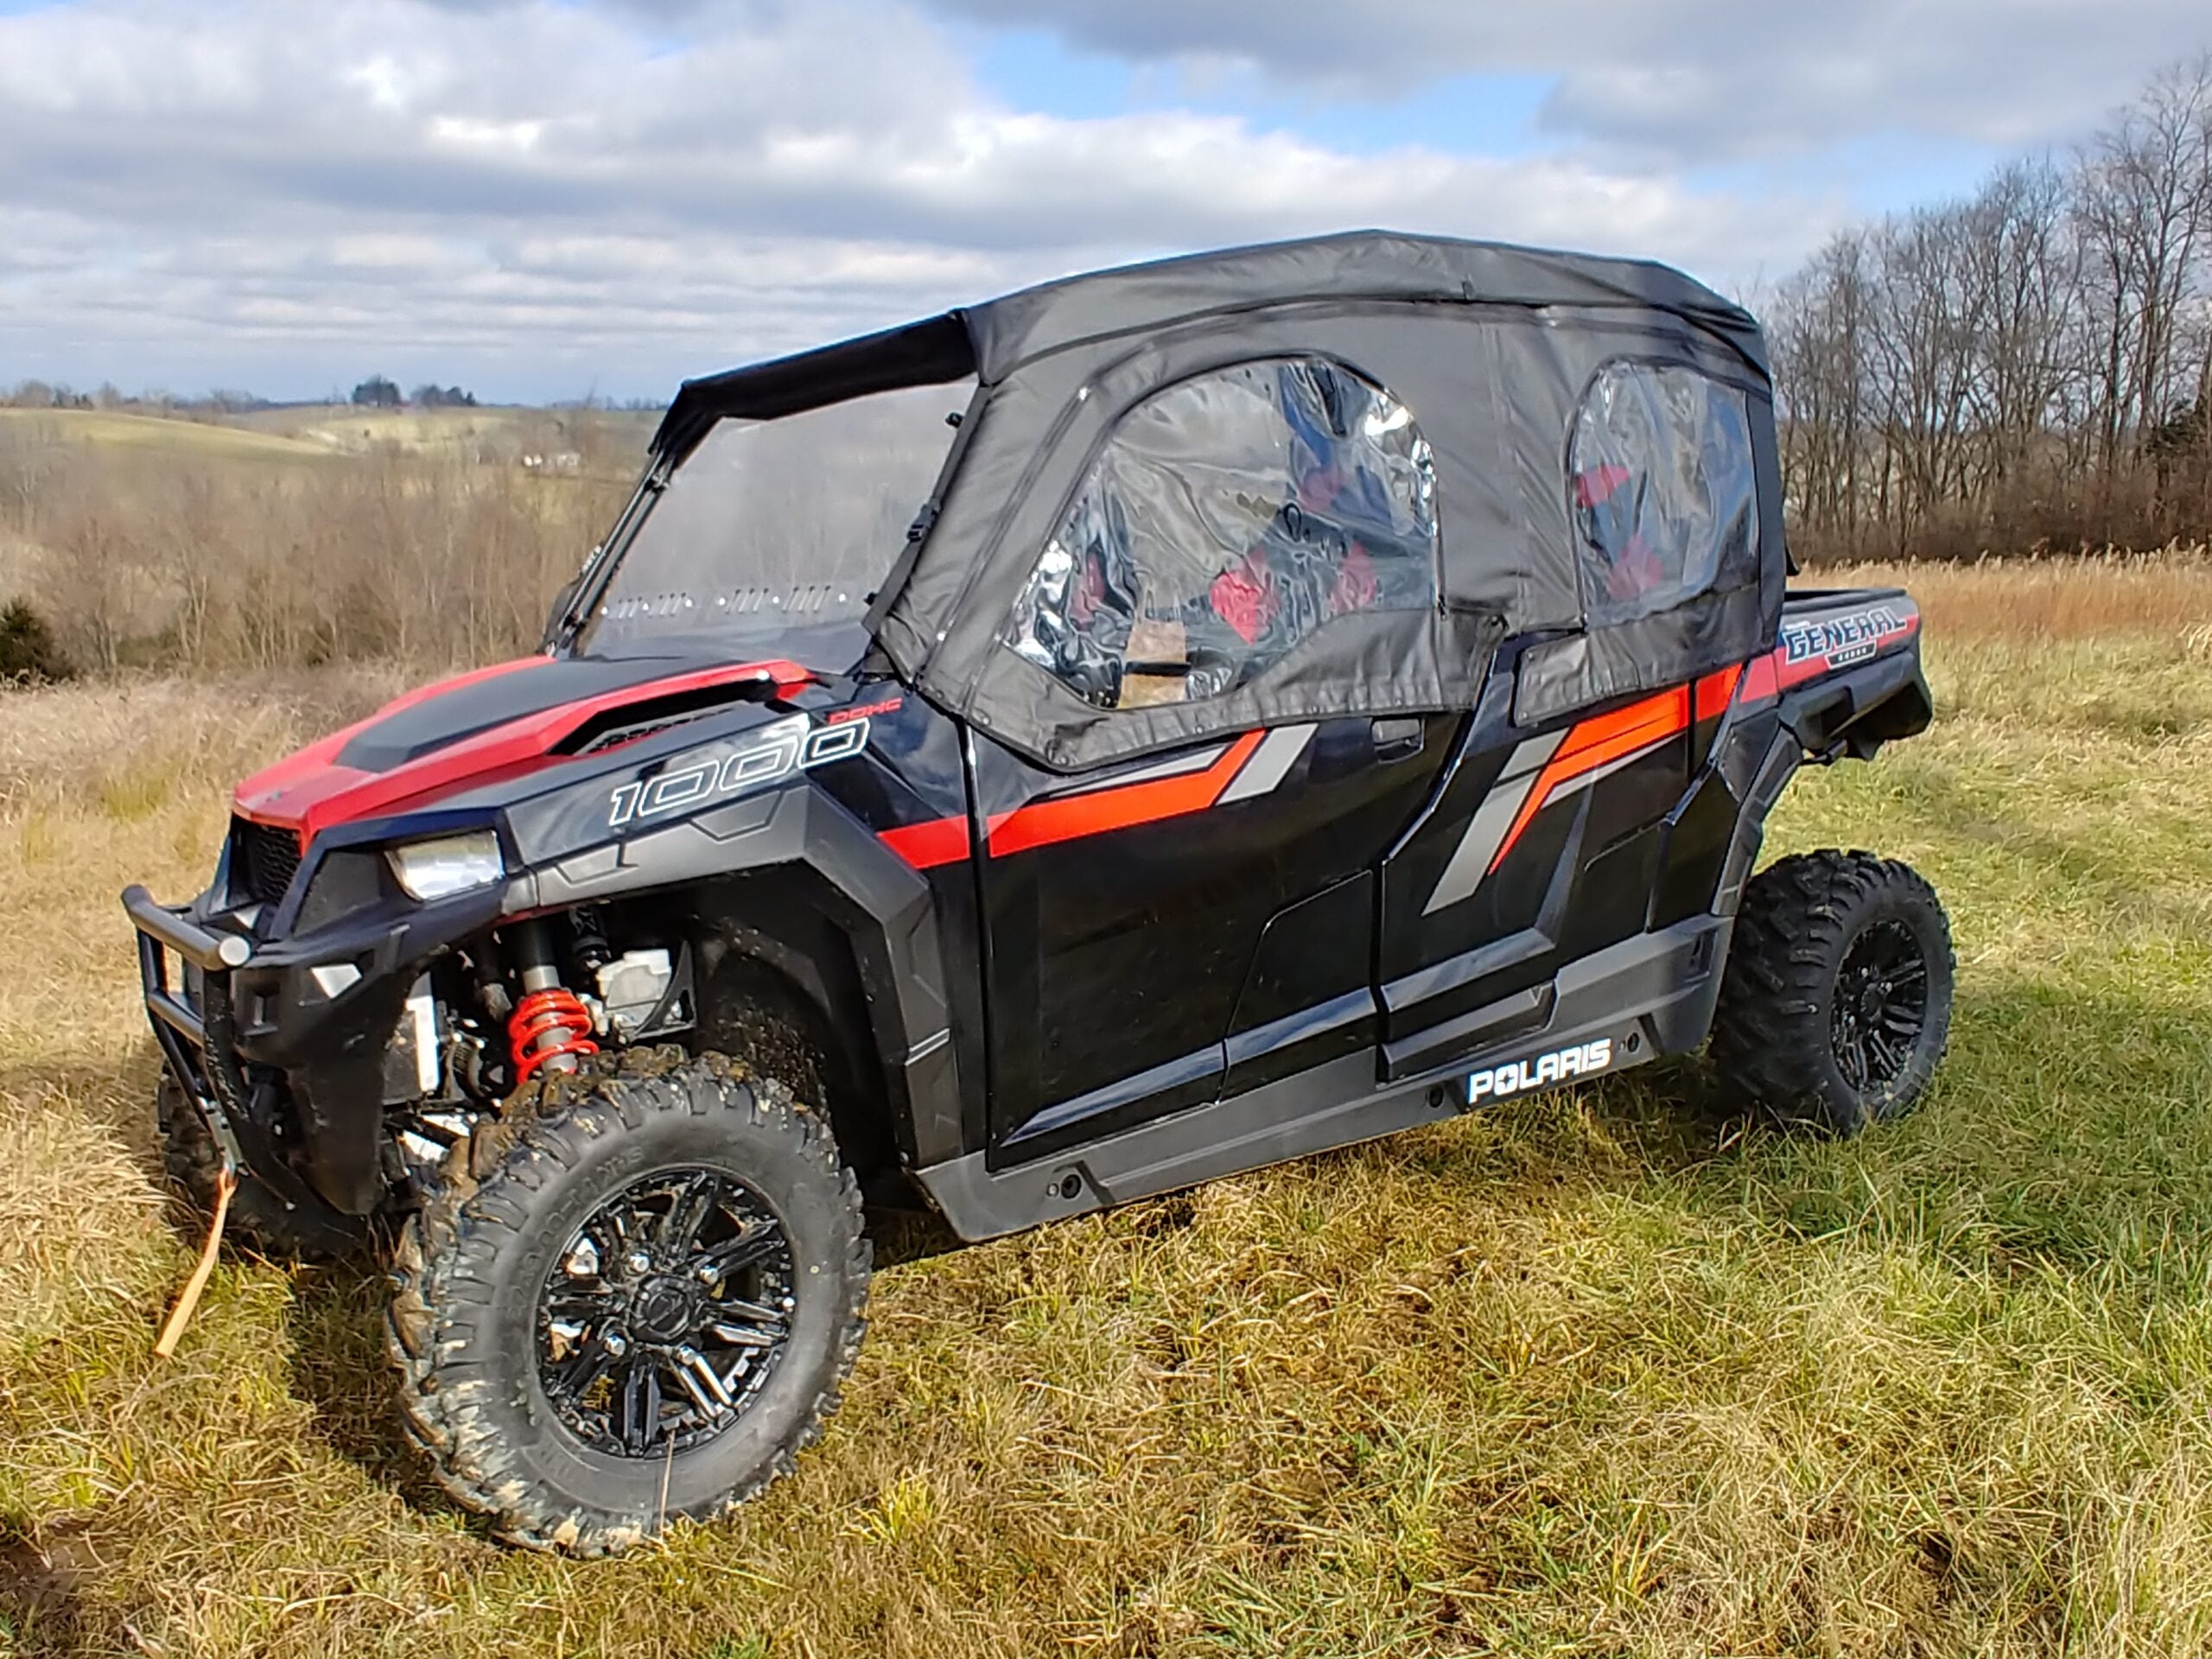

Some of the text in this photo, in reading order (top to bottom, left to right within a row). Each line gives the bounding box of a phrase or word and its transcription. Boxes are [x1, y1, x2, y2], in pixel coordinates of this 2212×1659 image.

[1782, 606, 1908, 665] GENERAL
[828, 696, 903, 725] DOHC
[608, 716, 871, 826] 1000
[1469, 1039, 1611, 1104] POLARIS
